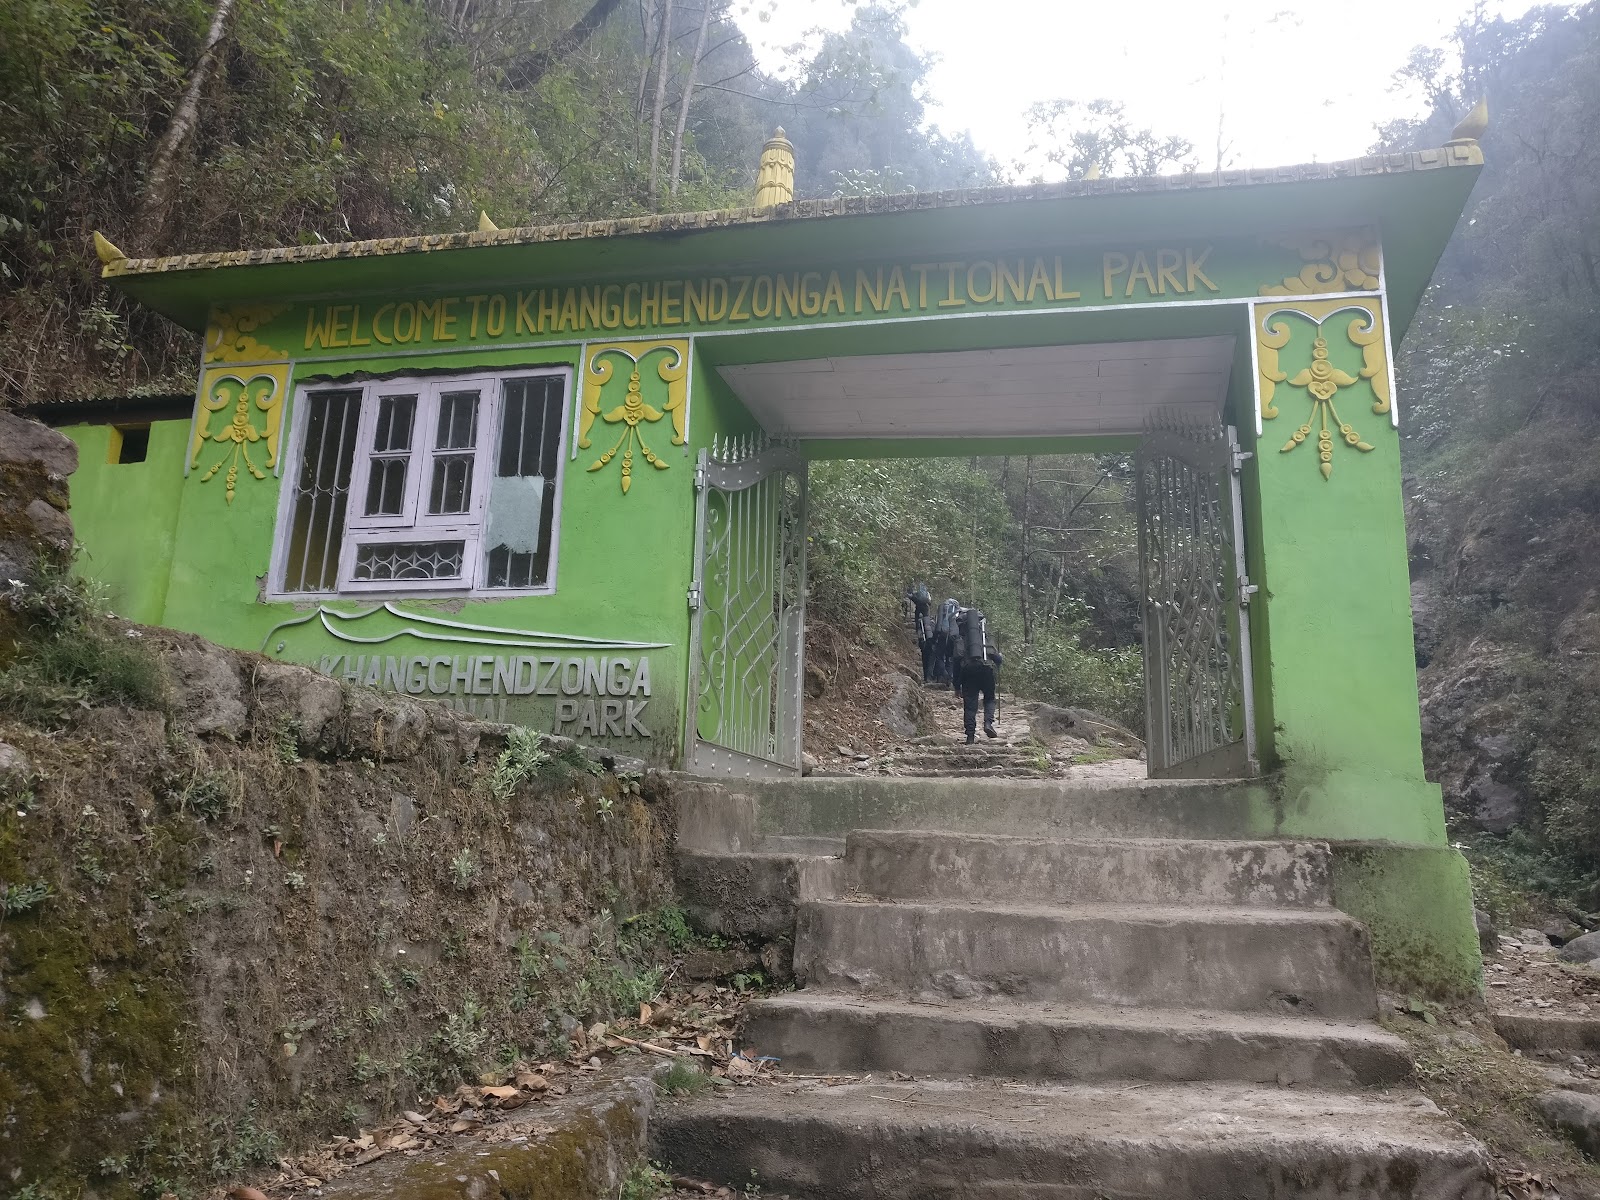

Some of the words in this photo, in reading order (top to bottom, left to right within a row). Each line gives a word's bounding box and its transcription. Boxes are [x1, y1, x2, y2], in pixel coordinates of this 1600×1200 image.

[304, 296, 459, 349] WELCOME
[467, 294, 506, 340] TO
[515, 269, 846, 336] KHANGCHENDZONGA
[855, 255, 1080, 314] NATIONAL
[1102, 246, 1221, 298] PARK
[554, 699, 652, 738] PARK
